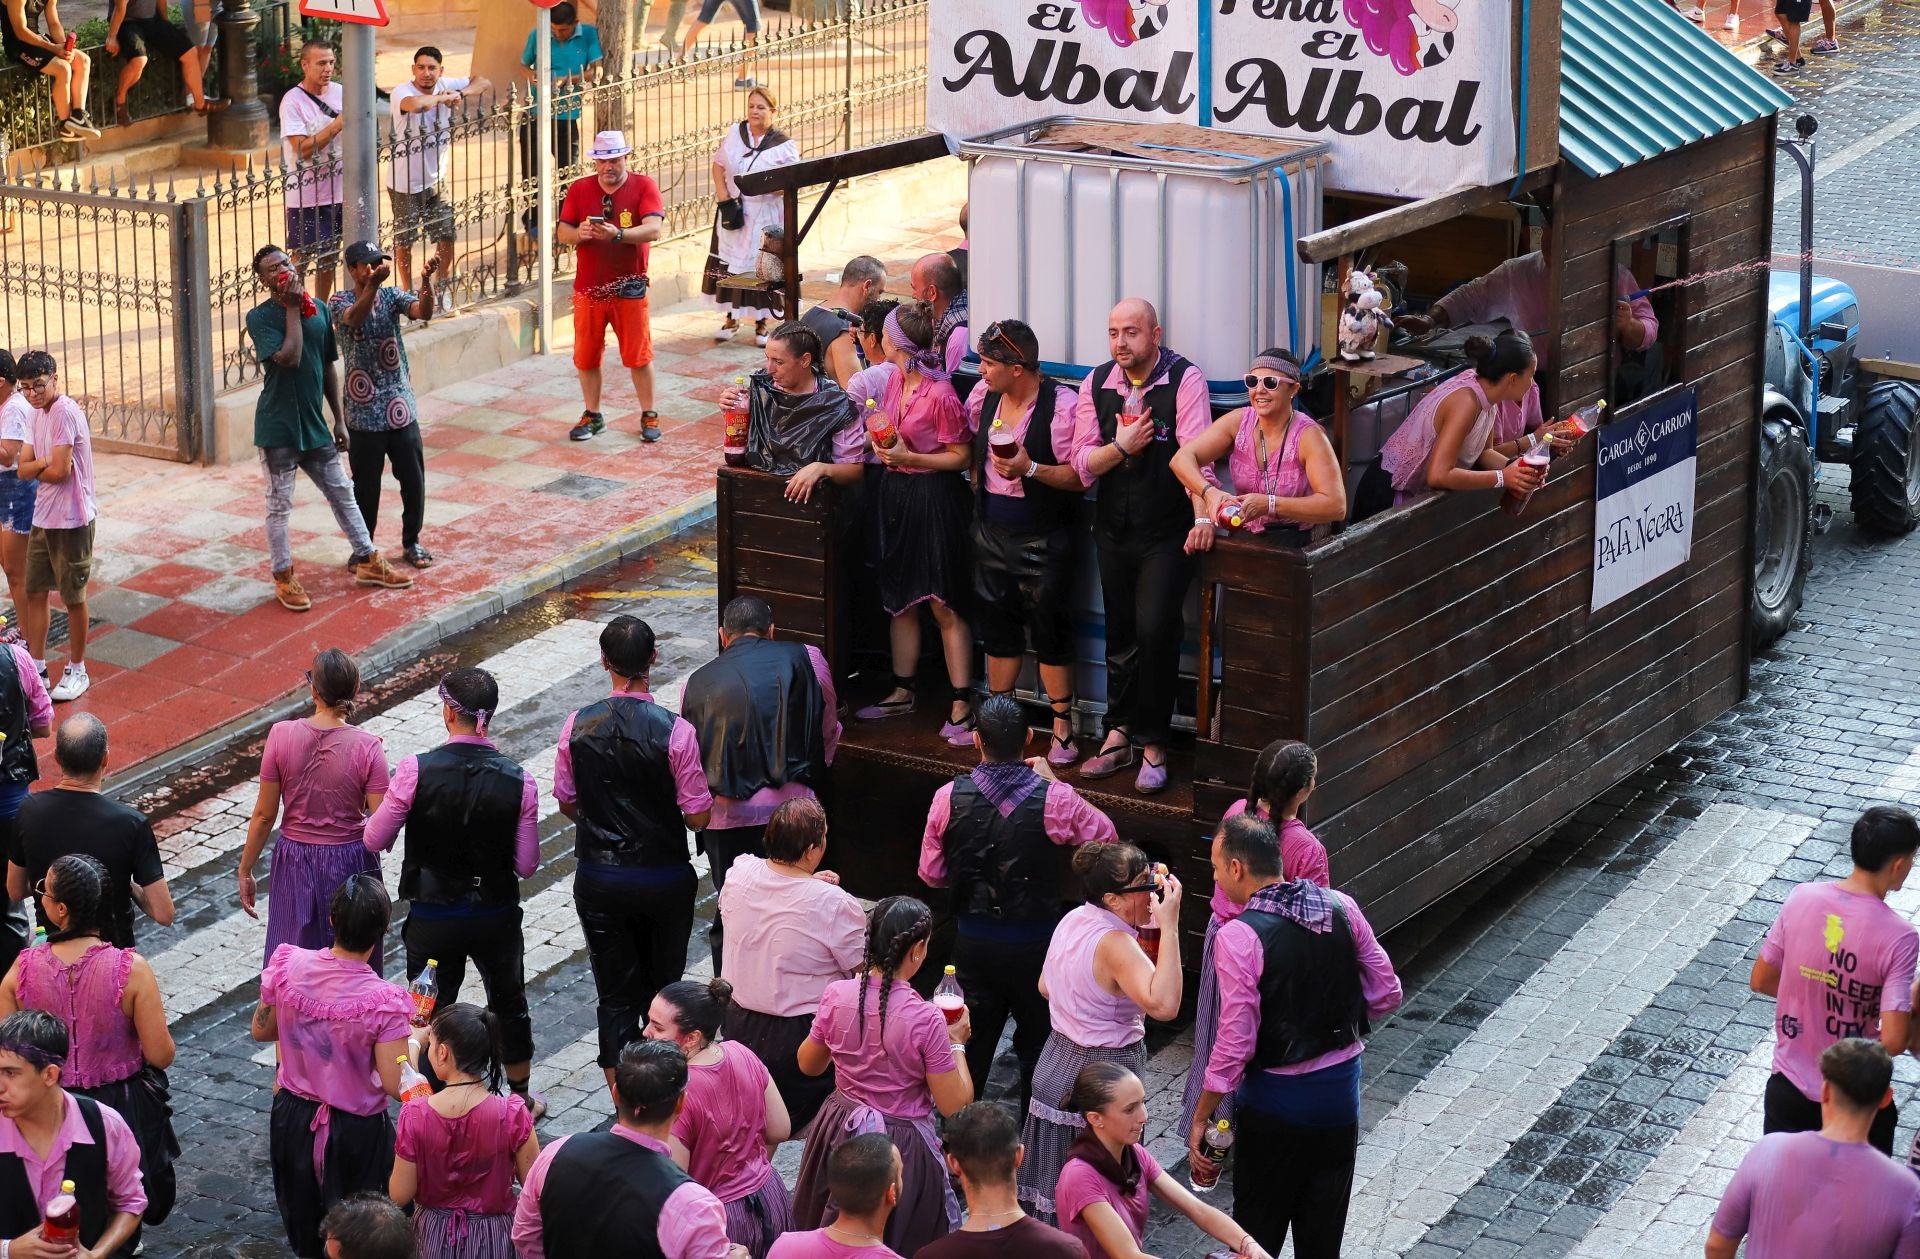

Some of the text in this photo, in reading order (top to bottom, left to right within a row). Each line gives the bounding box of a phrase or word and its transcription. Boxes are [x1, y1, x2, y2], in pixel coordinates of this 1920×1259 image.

[1027, 3, 1077, 33] El
[1301, 30, 1359, 61] El
[942, 29, 1196, 116] Albal
[1213, 57, 1483, 147] Albal
[1598, 437, 1634, 467] GARCIA
[1651, 409, 1692, 442] CARRION
[1627, 452, 1657, 475] DESDE 1890
[1596, 502, 1685, 571] PATA NEGRA
[1830, 948, 1857, 973] NO
[1826, 992, 1844, 1017] IN
[1826, 1015, 1867, 1039] CITY
